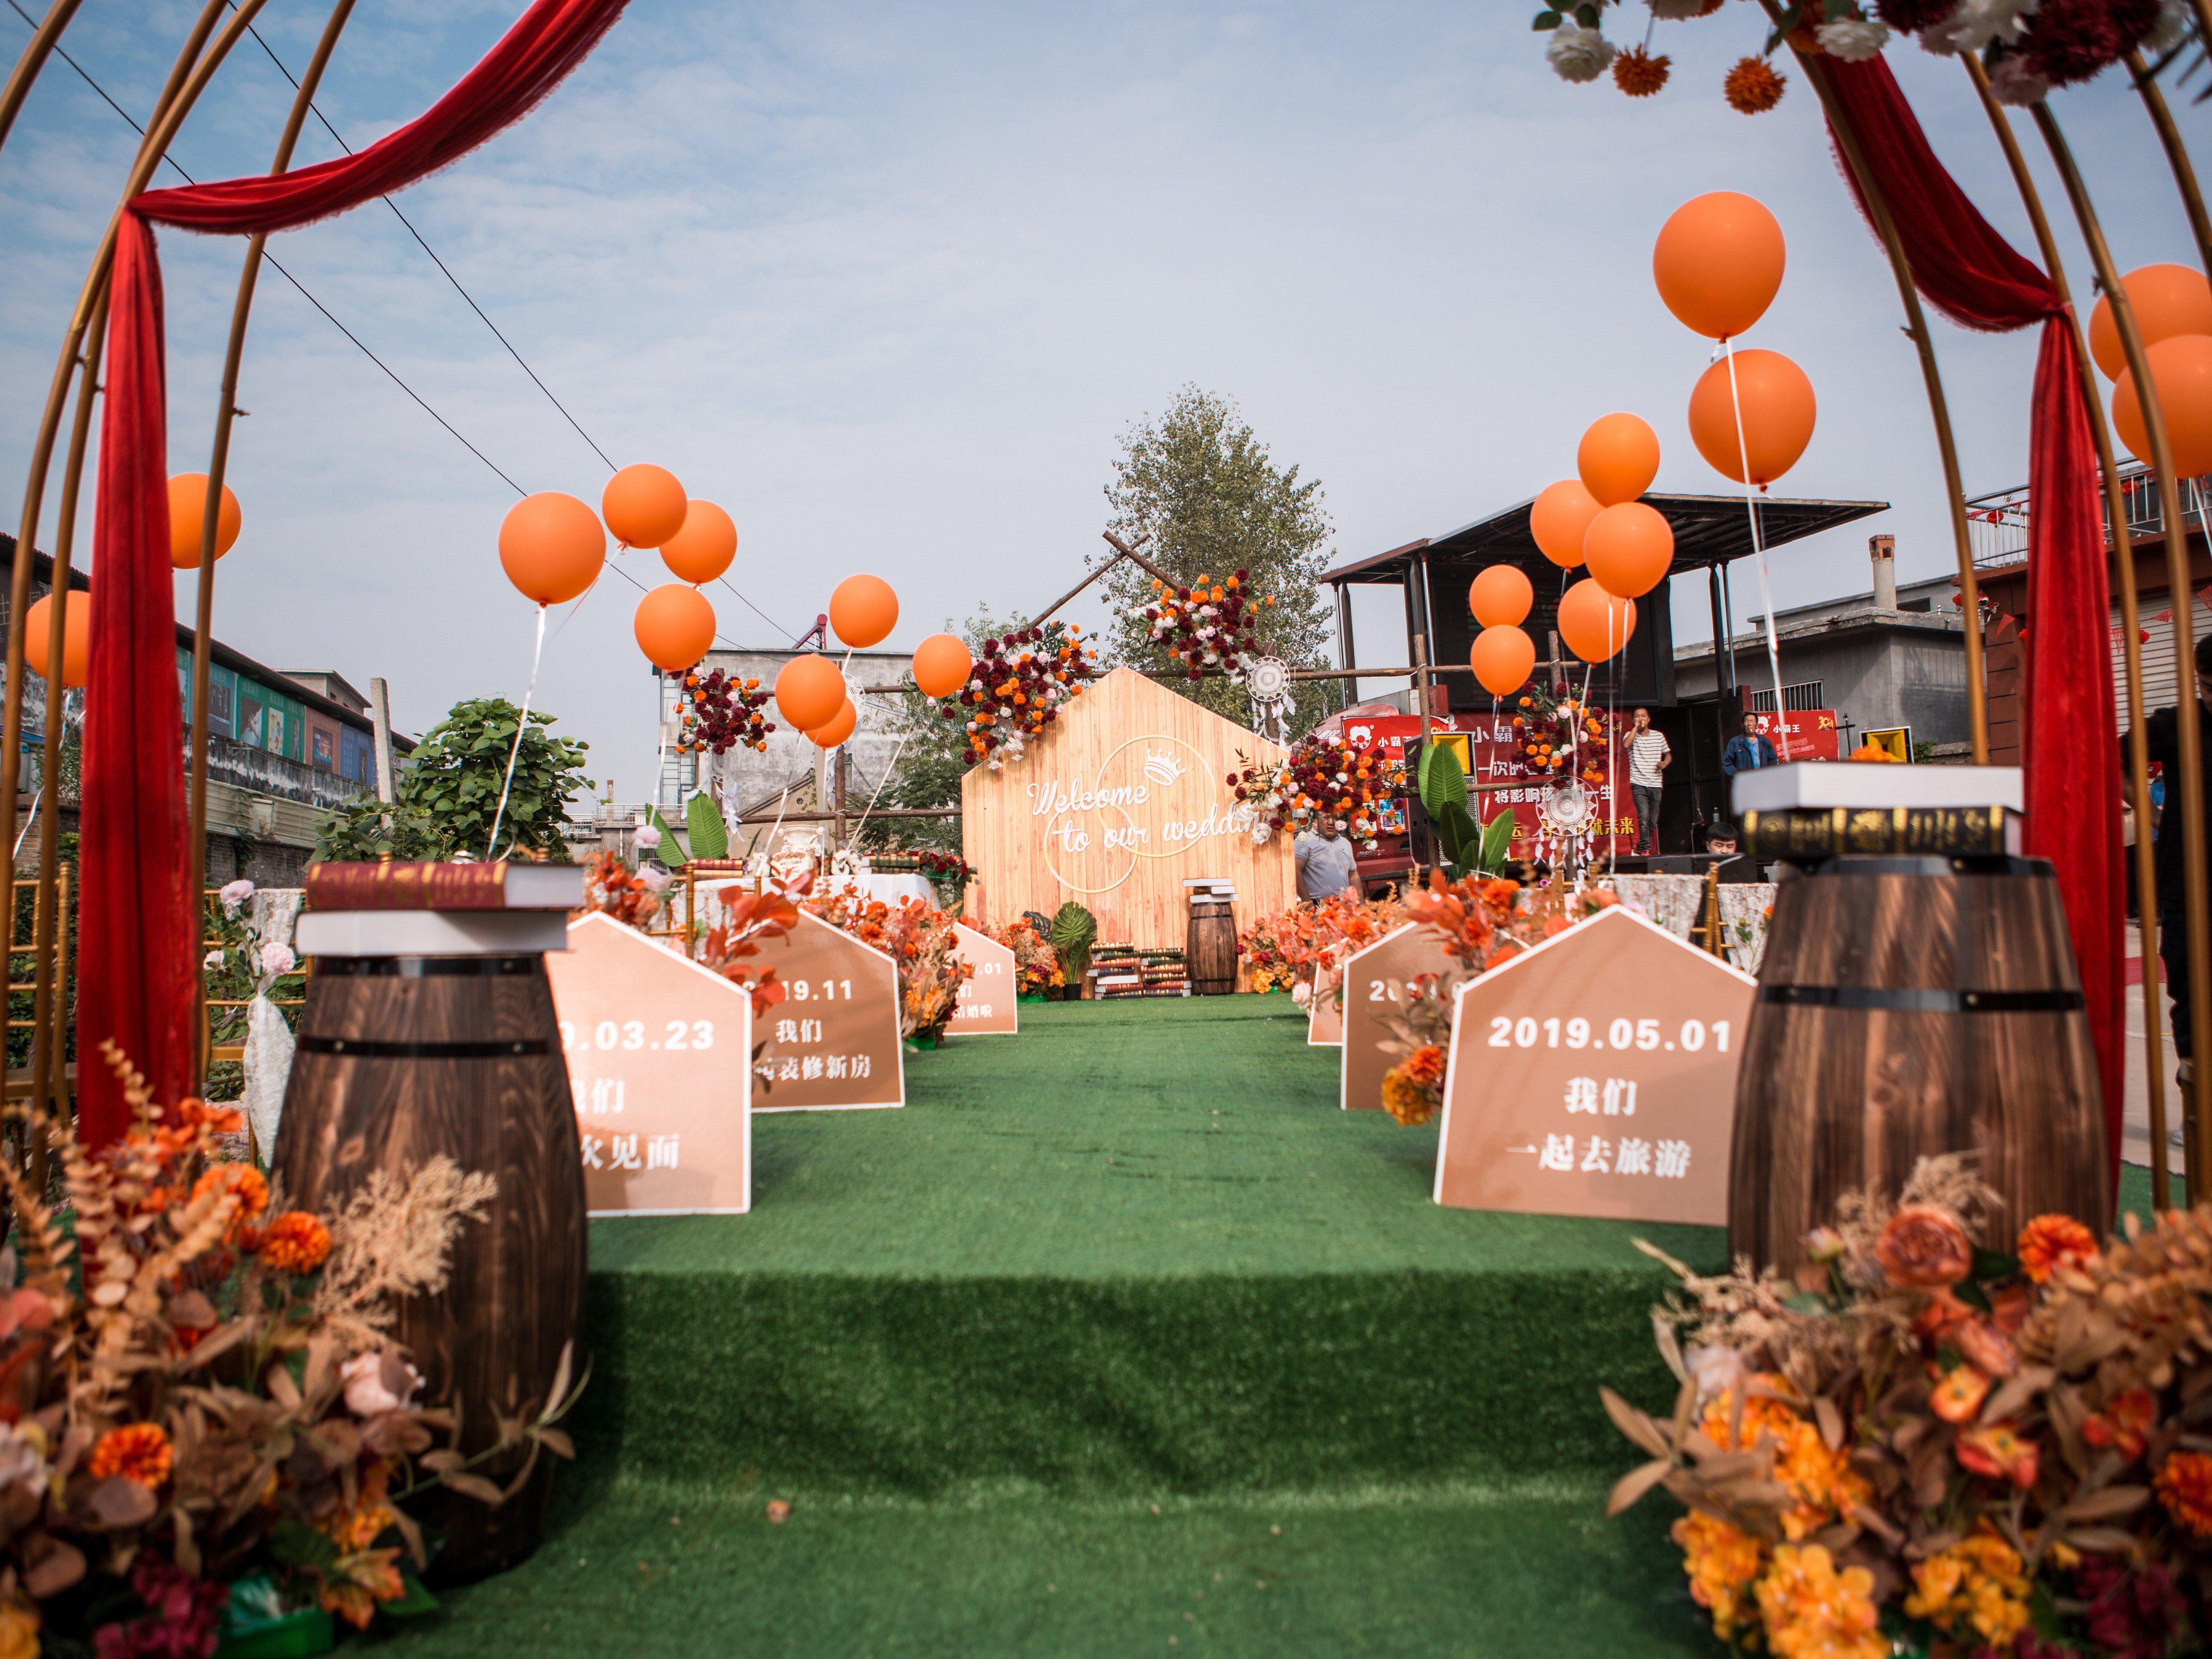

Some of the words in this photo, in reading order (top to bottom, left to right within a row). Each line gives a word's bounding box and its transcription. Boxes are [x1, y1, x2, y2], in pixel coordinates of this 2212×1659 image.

[1378, 736, 1412, 748] 小霸
[1473, 726, 1533, 744] 小霸
[1027, 778, 1151, 816] Welcome
[1052, 820, 1092, 853] to
[1104, 826, 1151, 849] our
[1163, 801, 1258, 842] weddin
[975, 963, 1001, 975] .01
[775, 1019, 822, 1043] 我们
[1487, 1017, 1729, 1052] 2019.05.01
[1564, 1077, 1638, 1116] 我们
[1504, 1133, 1692, 1178] 一起去旅游
